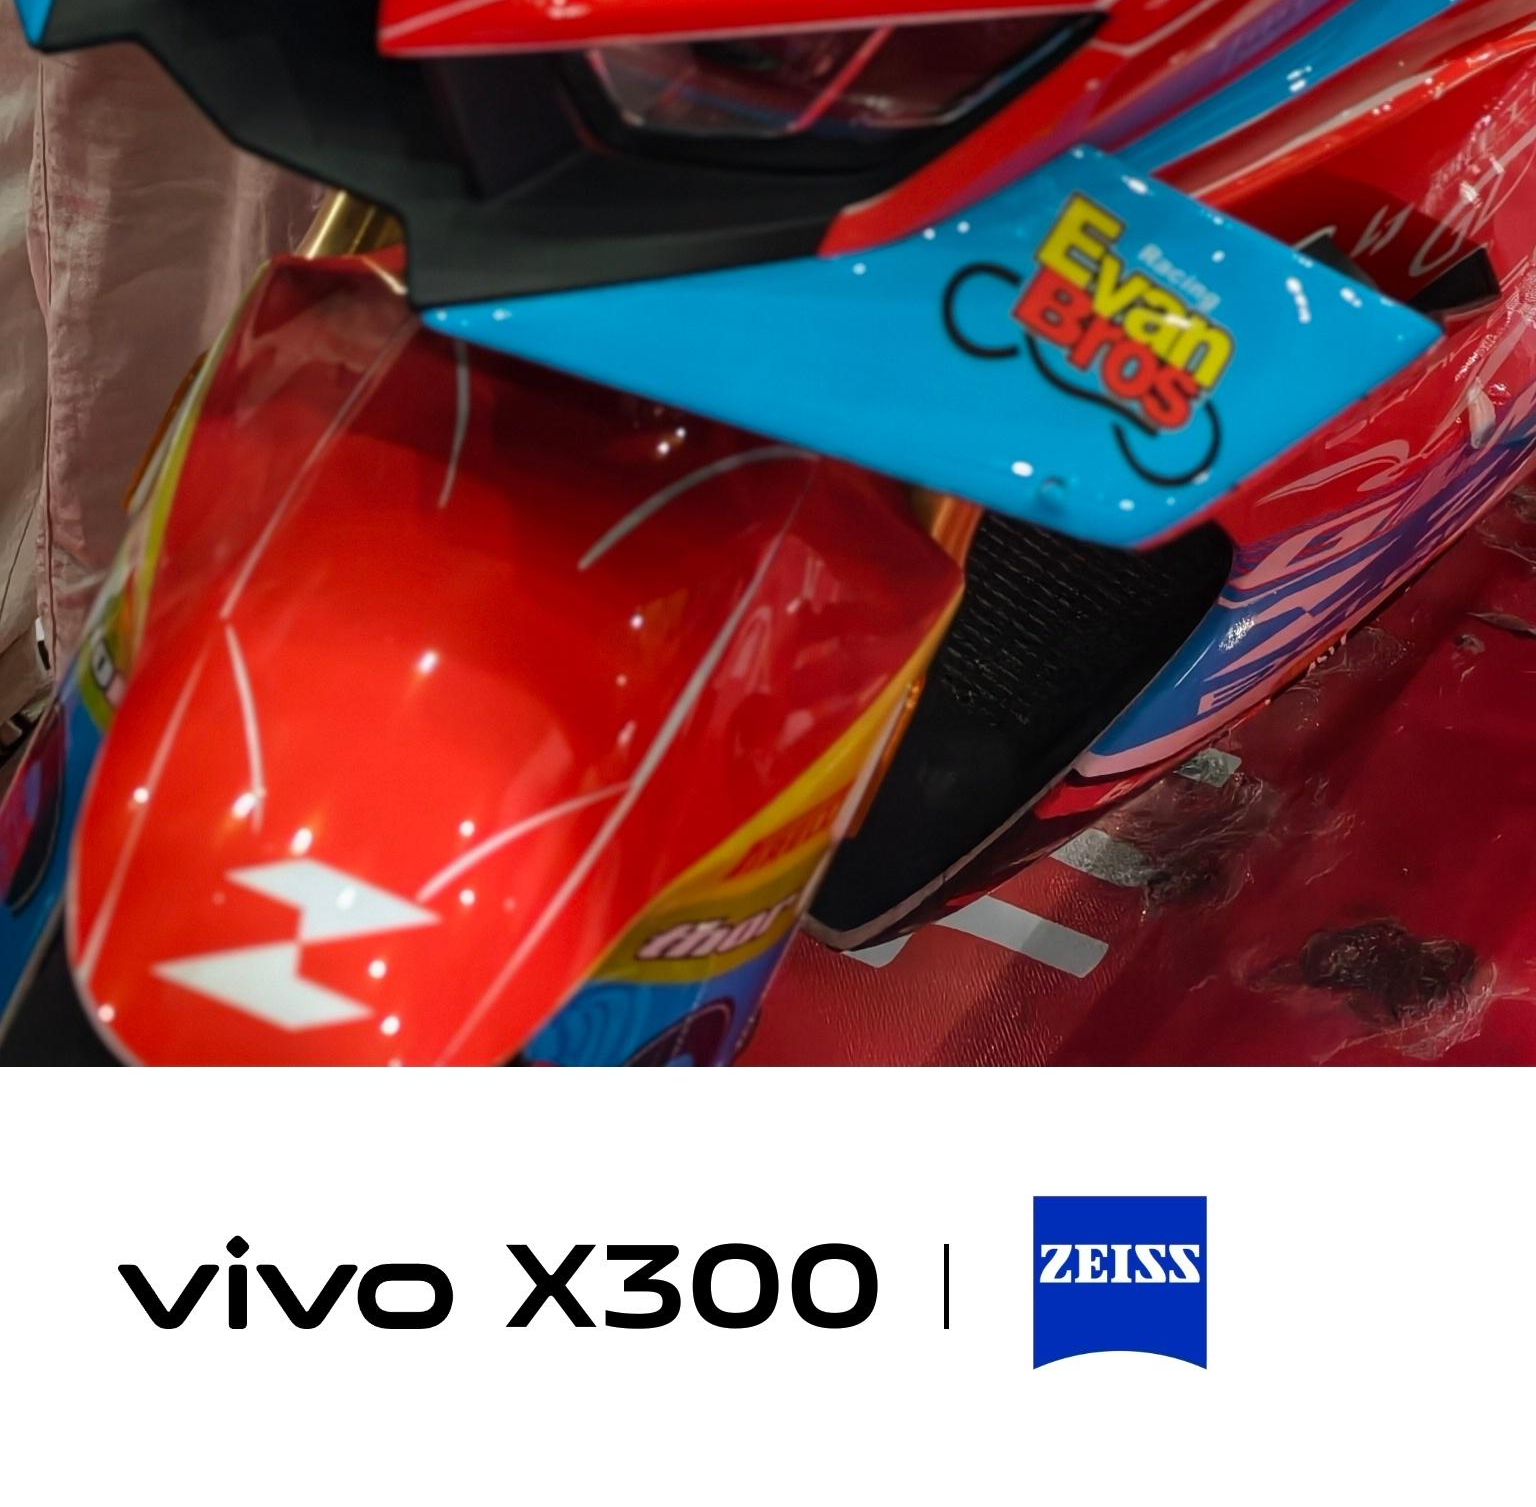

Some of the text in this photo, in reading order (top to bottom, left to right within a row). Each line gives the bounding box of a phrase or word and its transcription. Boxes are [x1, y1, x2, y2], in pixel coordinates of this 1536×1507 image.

[1011, 265, 1202, 430] Bros
[1034, 189, 1237, 393] Evan
[1137, 241, 1222, 314] Racing
